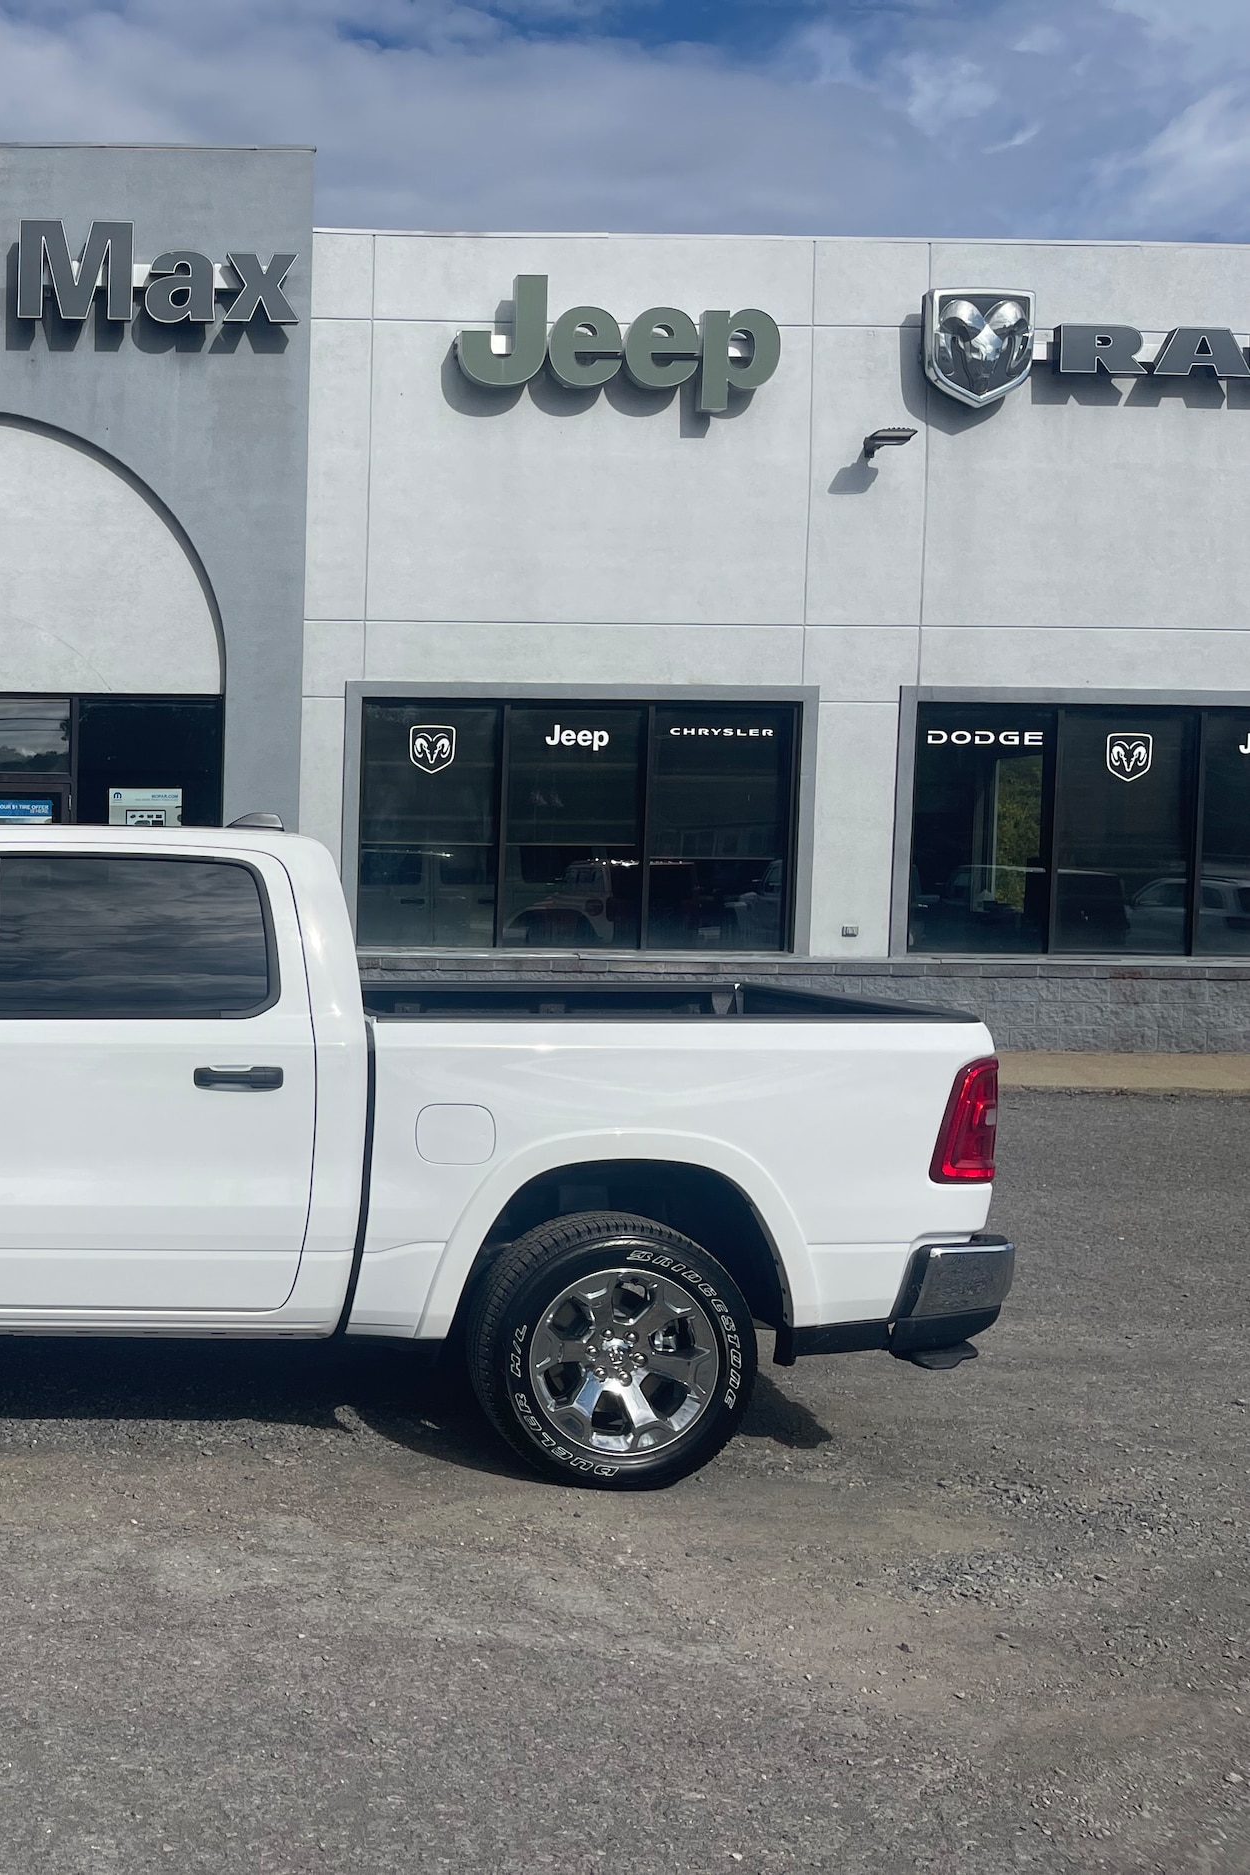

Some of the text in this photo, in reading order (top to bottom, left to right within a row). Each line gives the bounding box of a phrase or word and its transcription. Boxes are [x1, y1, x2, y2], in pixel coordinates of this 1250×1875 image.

[15, 217, 300, 323] Max
[456, 274, 782, 413] Jeep
[1054, 322, 1250, 377] RA
[545, 724, 610, 751] Jeep
[669, 727, 775, 737] CHRYSLER
[927, 730, 1044, 746] DODGE
[626, 1249, 743, 1410] BRIDGESTONE
[515, 1391, 620, 1477] DUELER
